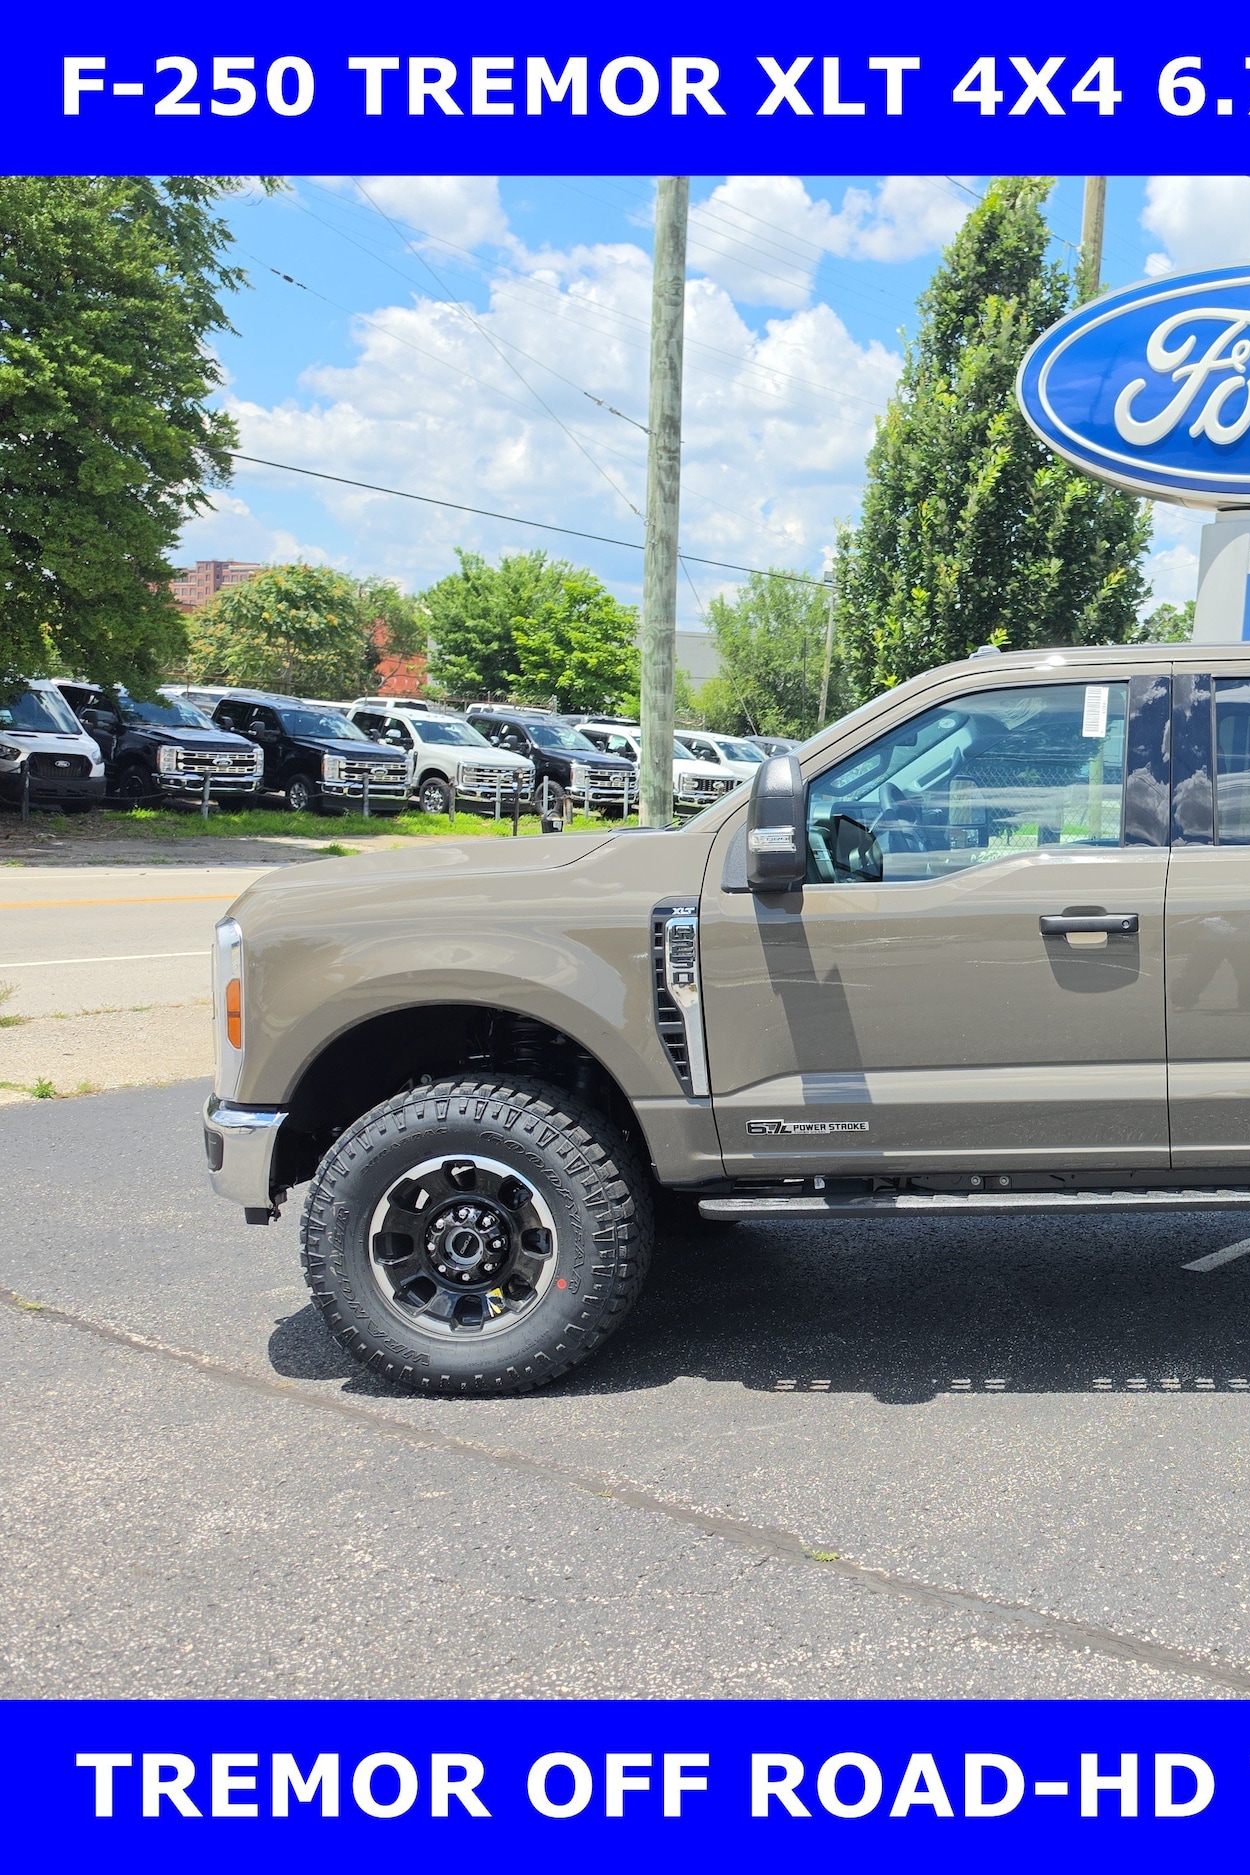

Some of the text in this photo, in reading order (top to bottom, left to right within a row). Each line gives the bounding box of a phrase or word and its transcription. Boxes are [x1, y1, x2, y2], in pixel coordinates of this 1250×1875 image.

[671, 907, 695, 916] XLT
[828, 1123, 866, 1131] STROKE
[478, 1130, 585, 1295] GOODYEAR
